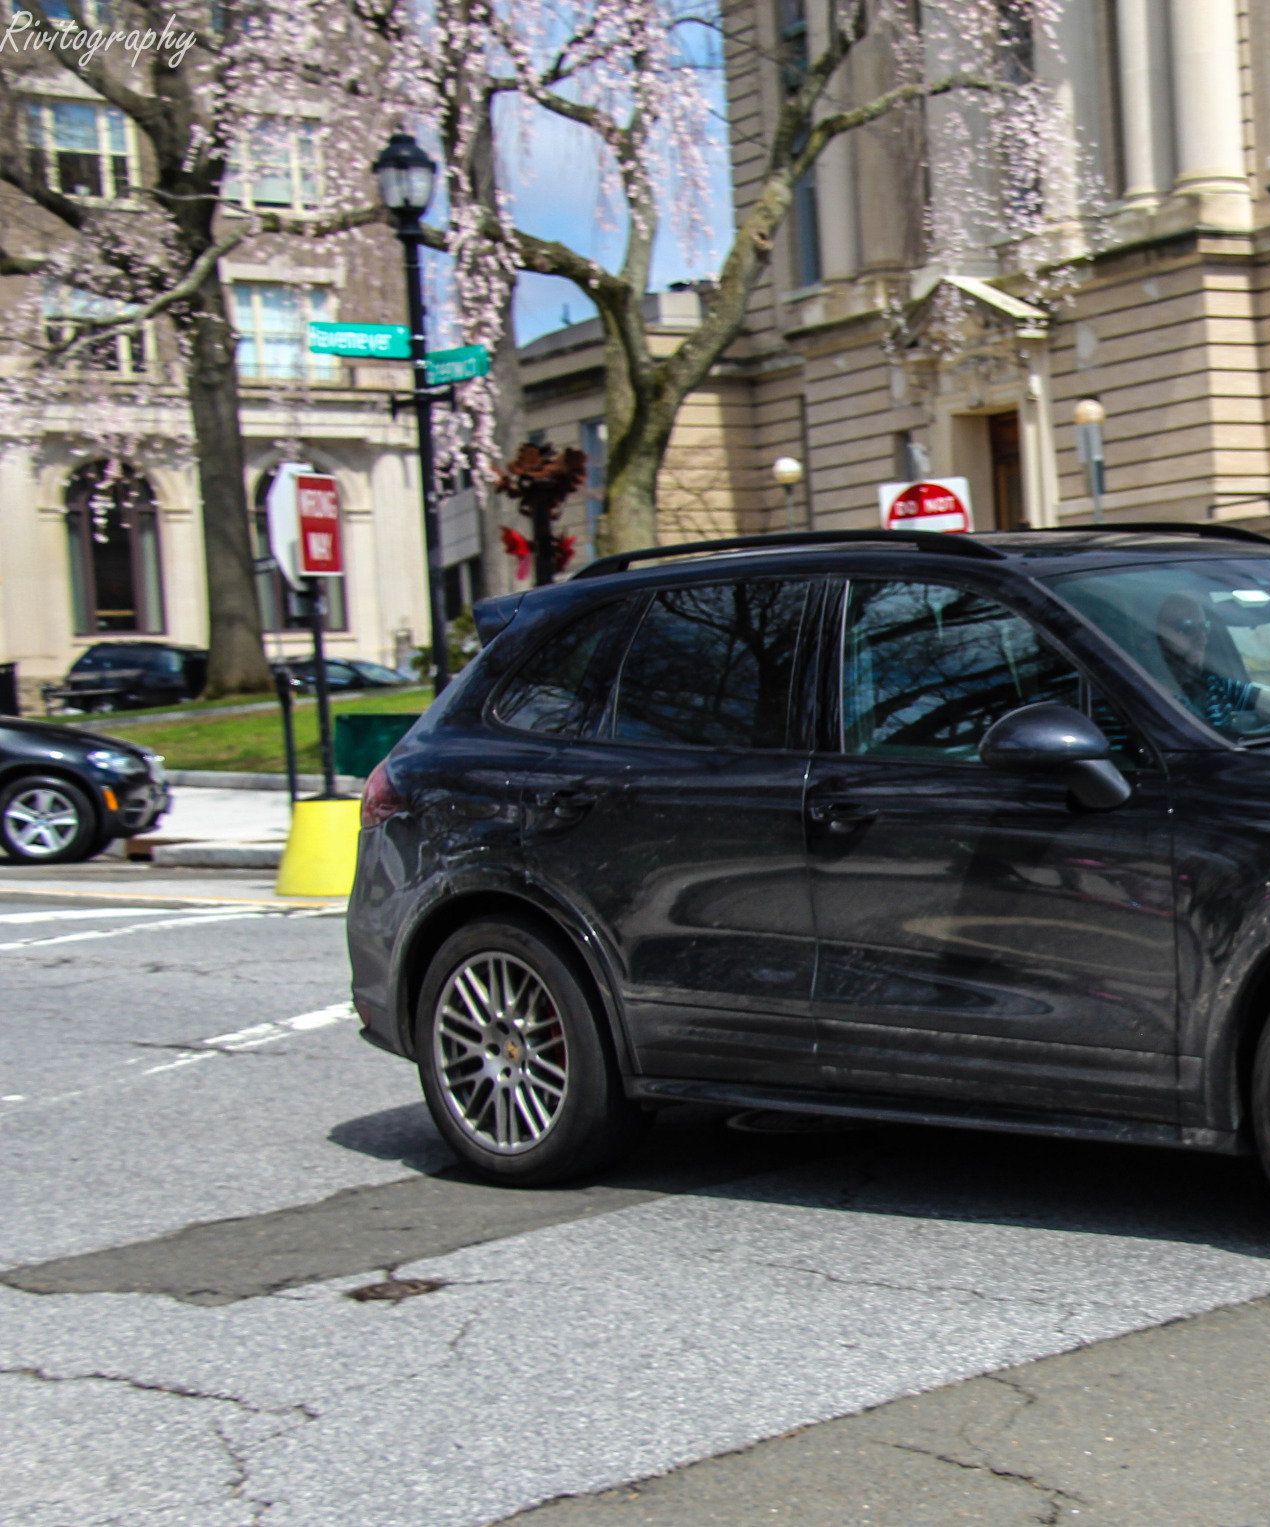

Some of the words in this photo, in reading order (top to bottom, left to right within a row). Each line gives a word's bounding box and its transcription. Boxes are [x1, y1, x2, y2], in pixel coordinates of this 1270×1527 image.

[298, 489, 338, 520] WRONG
[894, 500, 919, 517] DO
[922, 495, 955, 513] NOT
[306, 531, 334, 561] WAY
